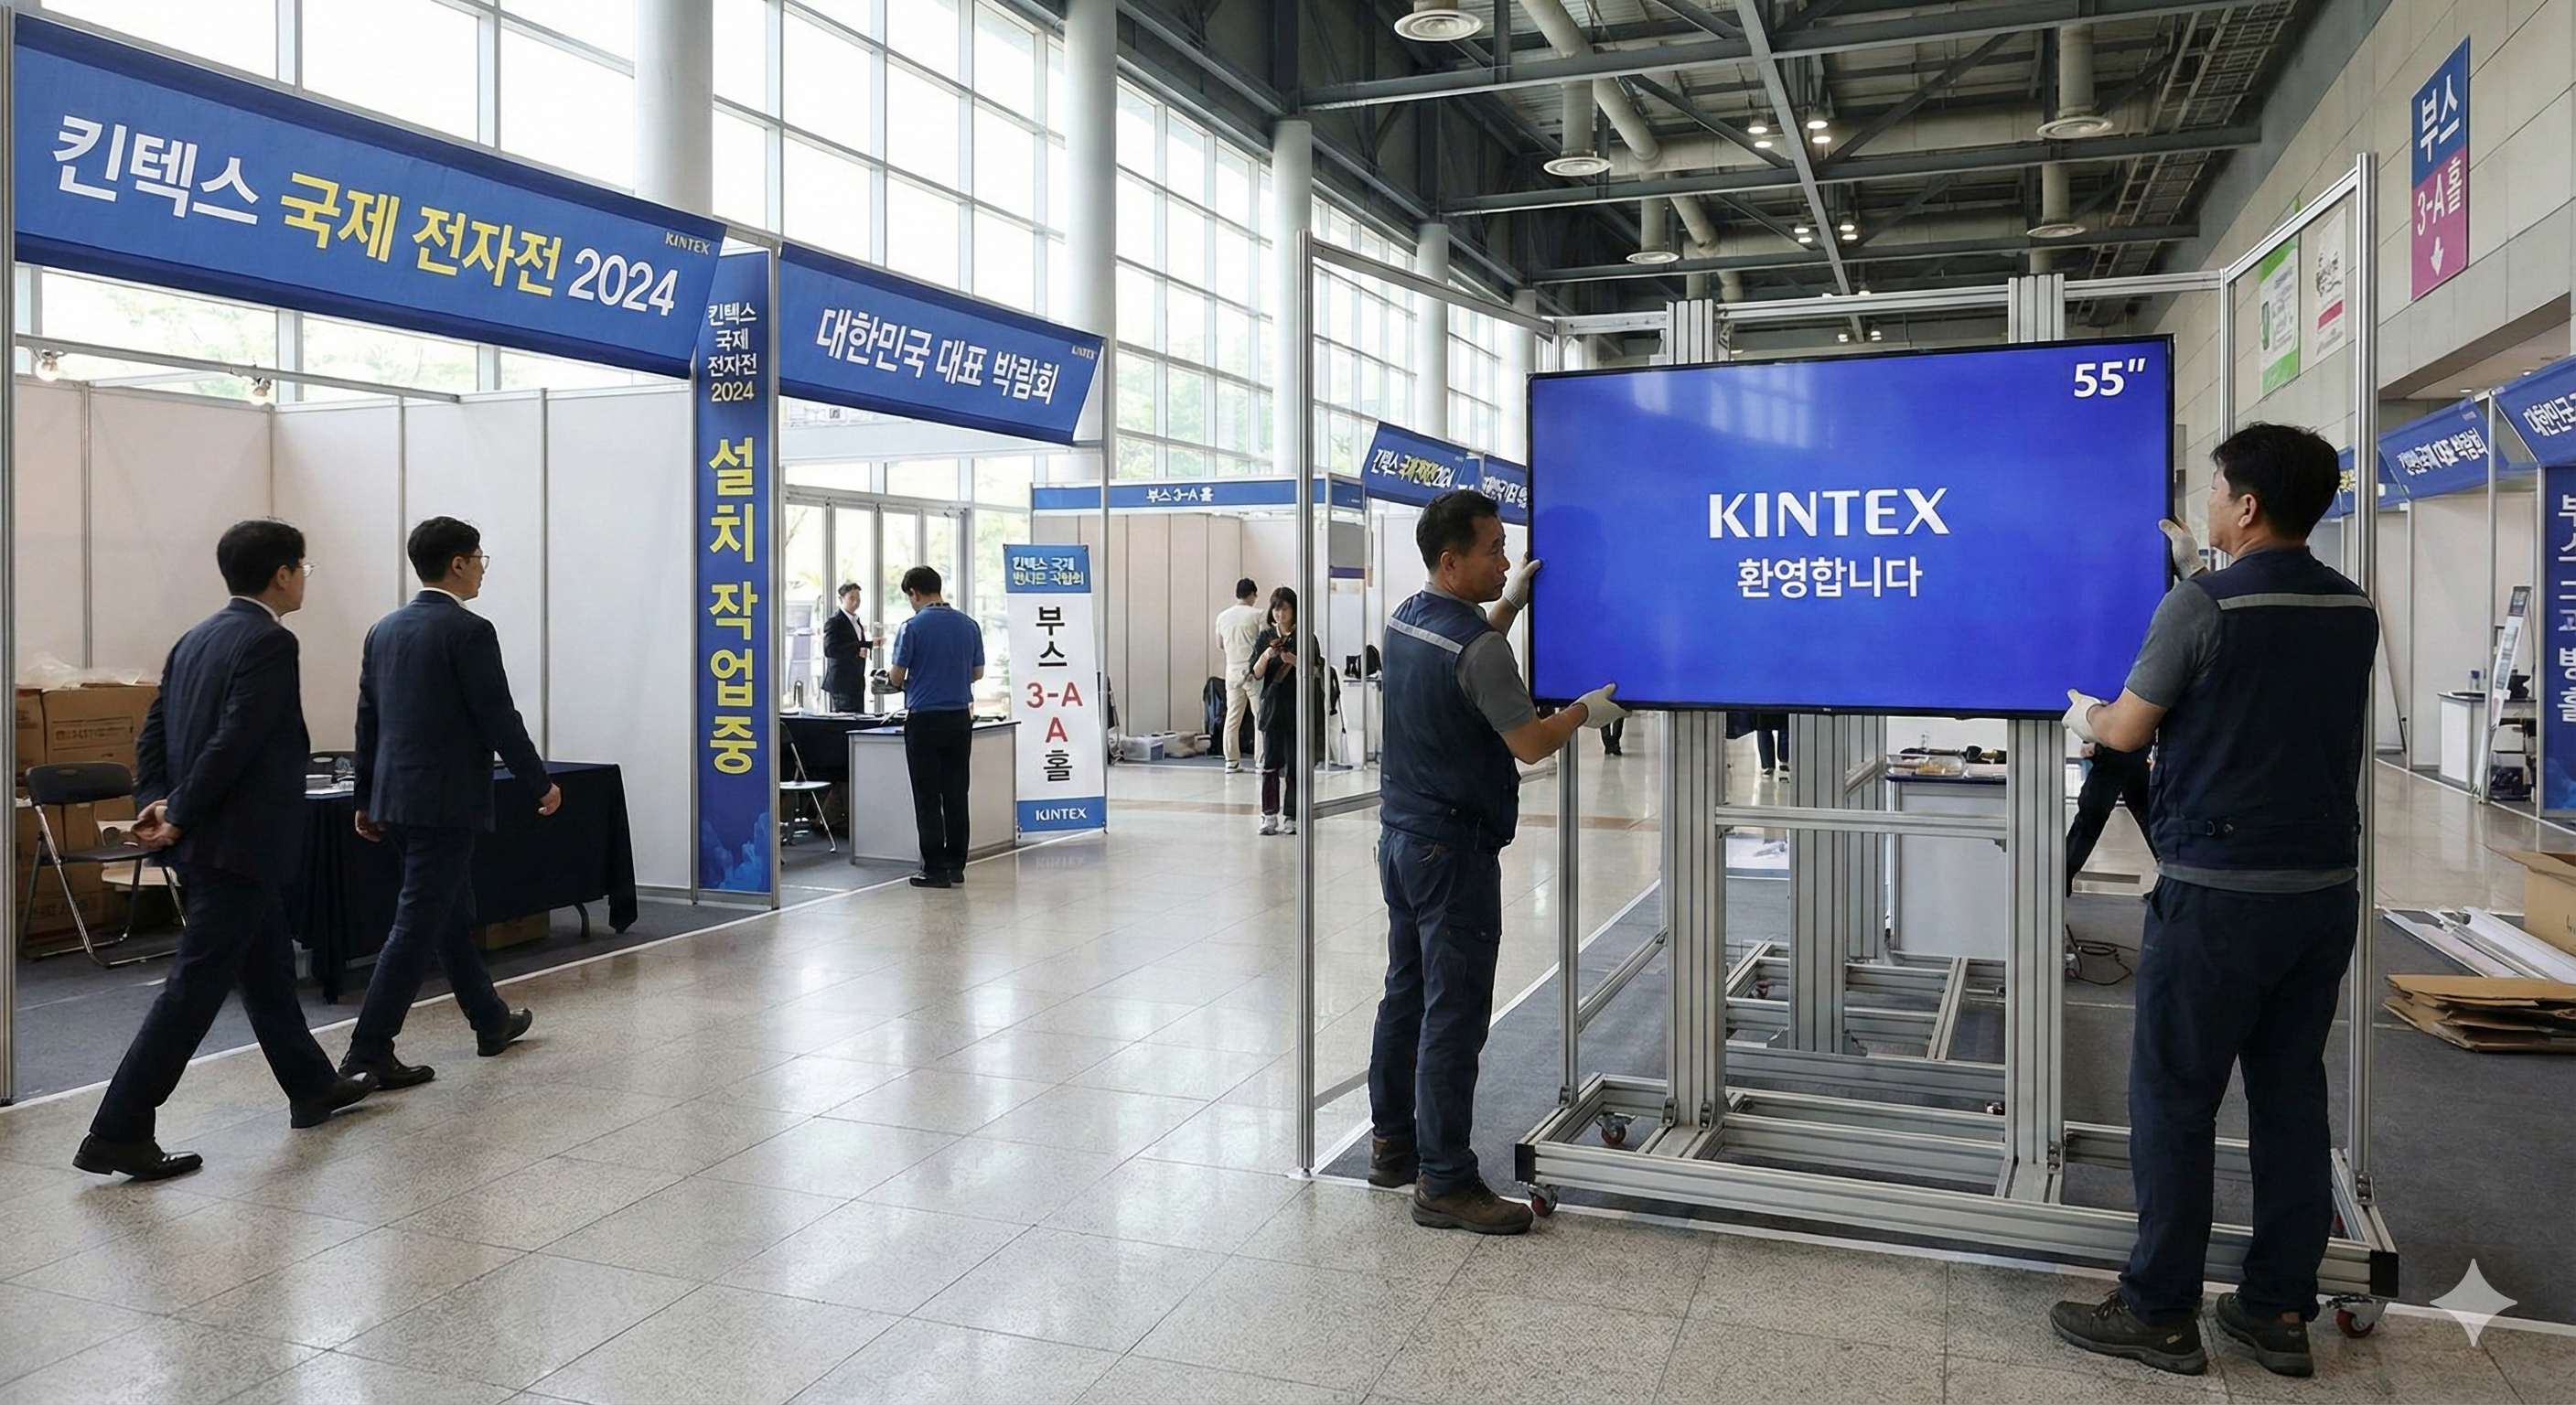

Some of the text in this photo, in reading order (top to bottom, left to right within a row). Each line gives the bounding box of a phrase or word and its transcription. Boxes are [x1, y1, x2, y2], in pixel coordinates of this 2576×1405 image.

[2420, 74, 2460, 163] 부스
[53, 115, 679, 316] 킨텍스 국제 전자전 2024
[665, 231, 711, 255] KINTEX
[708, 302, 757, 327] 킨텍스
[715, 327, 748, 352] 국제
[707, 352, 757, 377] 전자전
[817, 309, 1060, 405] 대한민국 대표 박람회
[711, 381, 755, 402] 2024
[1709, 488, 1950, 539] KINTEX
[1737, 556, 1923, 598] 환영합니다
[1026, 681, 1083, 708] 3-A
[1045, 716, 1068, 743] A
[1043, 749, 1073, 782] 홀
